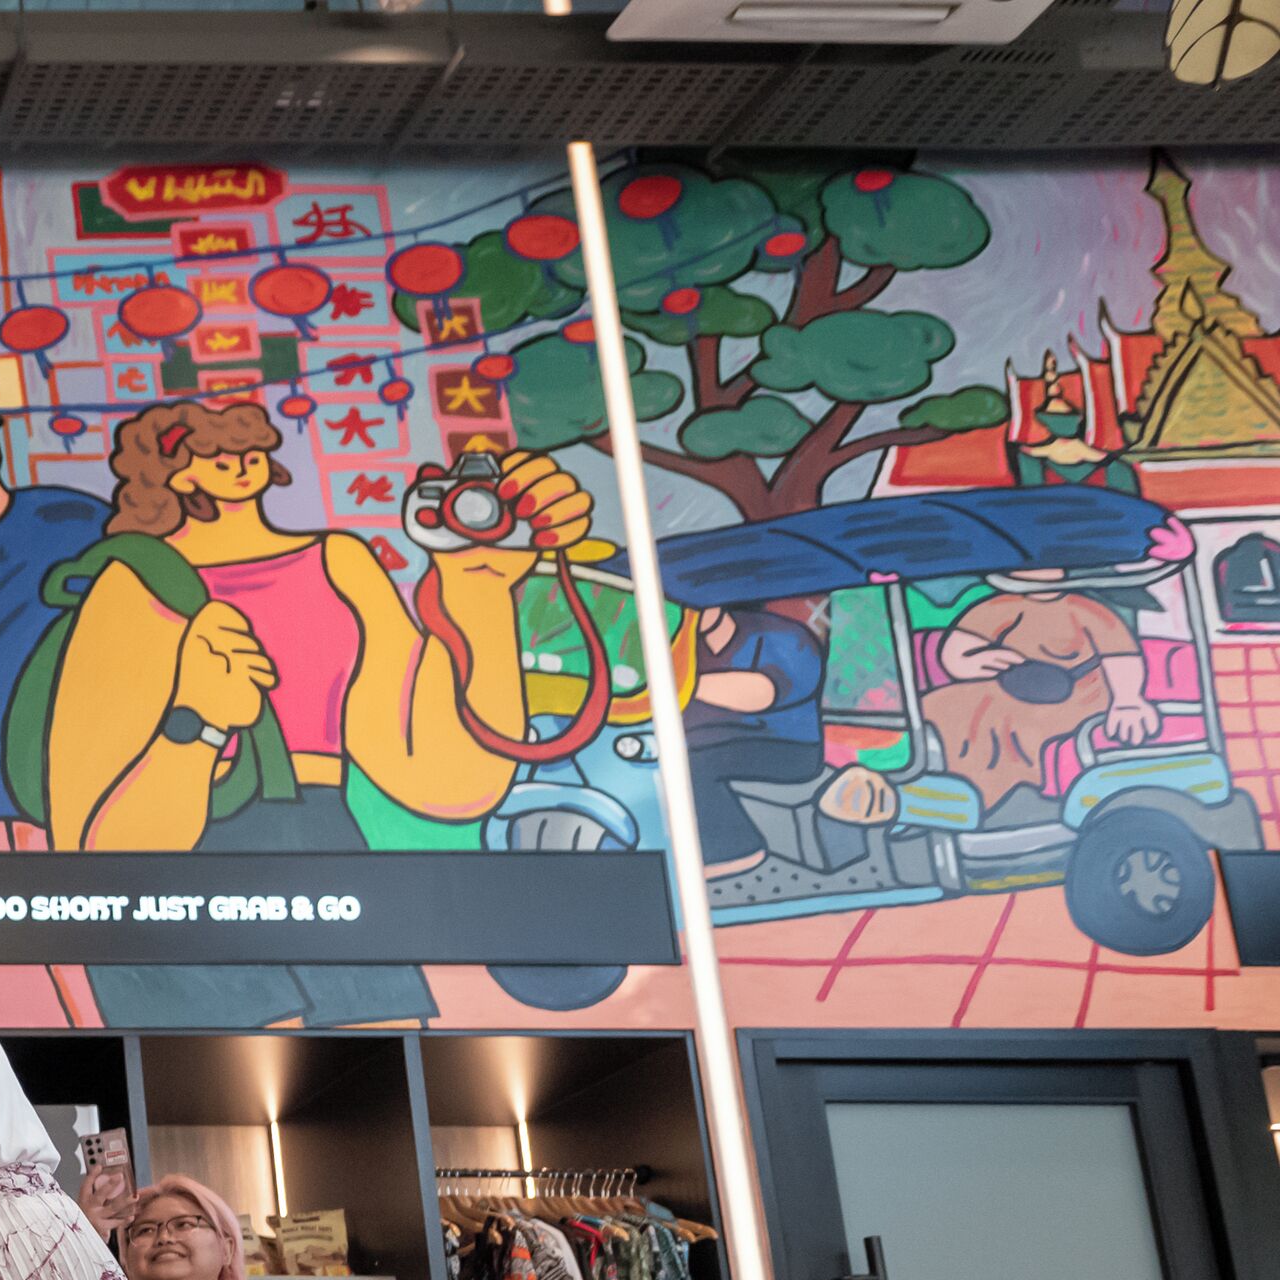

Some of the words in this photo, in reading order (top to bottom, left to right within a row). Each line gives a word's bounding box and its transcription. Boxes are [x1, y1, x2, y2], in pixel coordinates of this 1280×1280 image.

[30, 895, 129, 921] SHORT
[132, 895, 205, 921] JUST
[208, 895, 288, 921] GRAB
[290, 895, 315, 921] &
[317, 895, 361, 921] GO
